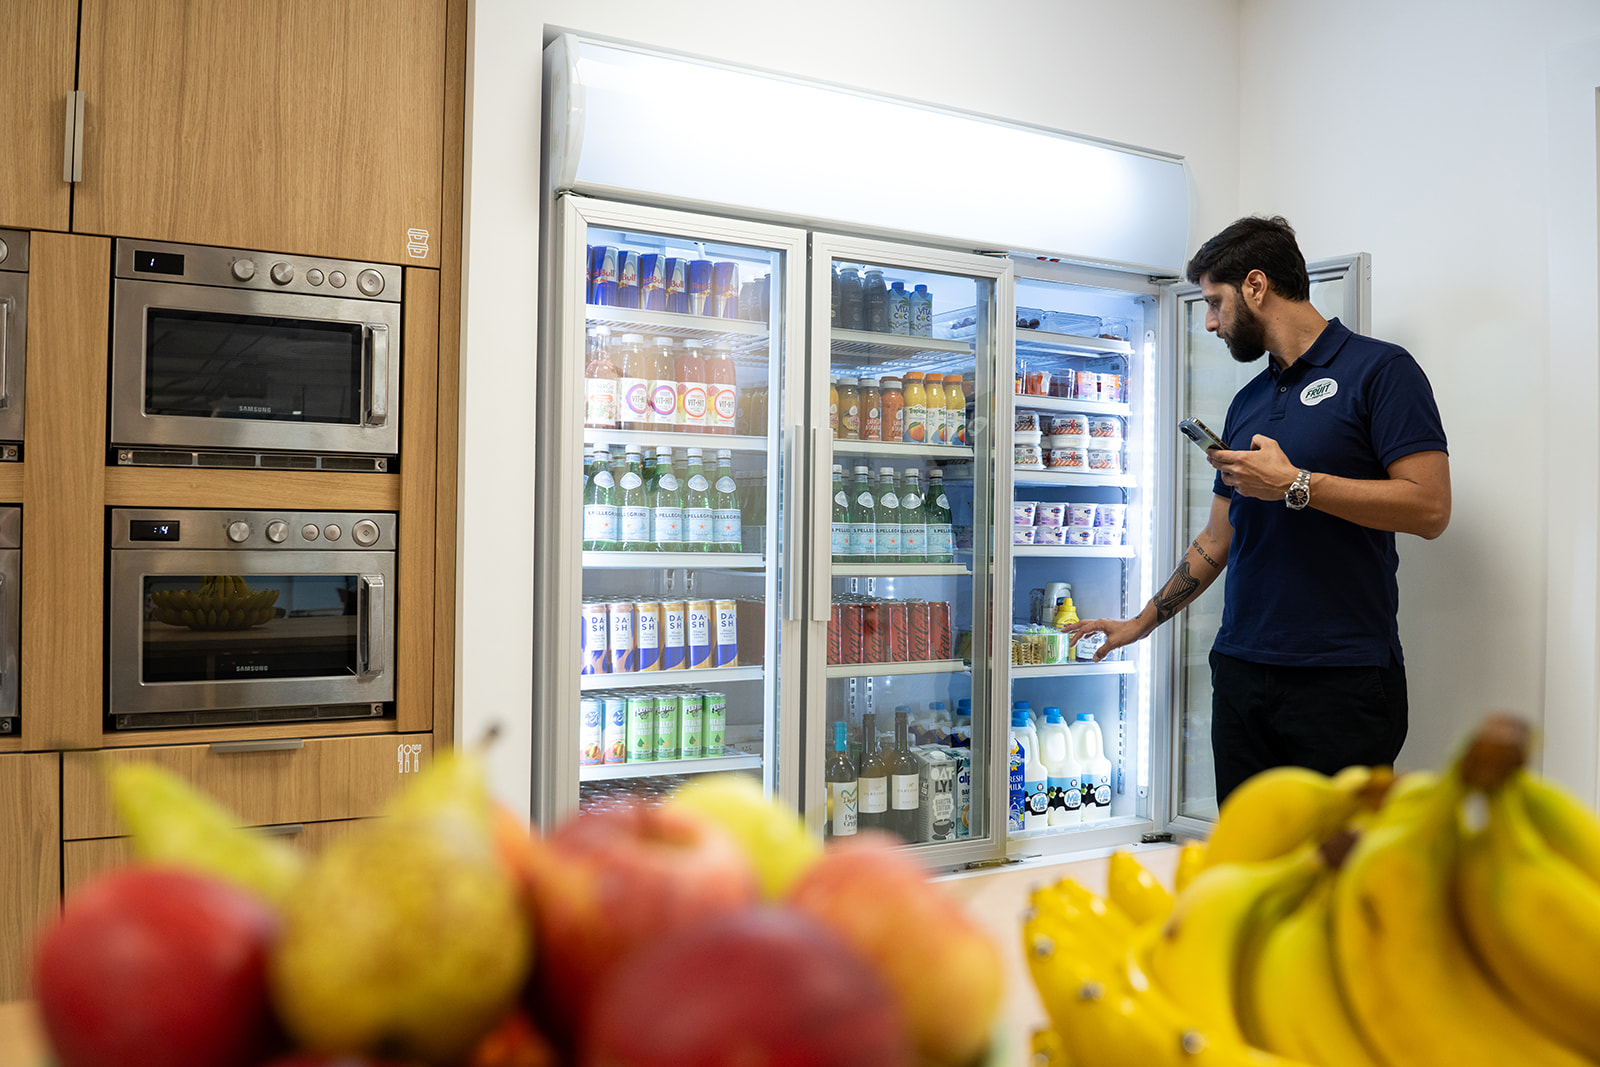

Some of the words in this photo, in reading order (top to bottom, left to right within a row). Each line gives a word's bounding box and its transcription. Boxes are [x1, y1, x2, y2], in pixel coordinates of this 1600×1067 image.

[600, 269, 615, 278] Bull
[621, 273, 636, 282] Bull
[692, 282, 707, 290] Red
[895, 304, 909, 313] VITA
[917, 307, 932, 316] VITA
[1305, 383, 1331, 398] FRUIT
[239, 405, 272, 413] SAMSUNG
[592, 624, 605, 632] SH
[615, 624, 628, 632] SH
[641, 623, 655, 631] SH
[669, 622, 682, 630] SH
[691, 621, 705, 629] SH
[721, 620, 734, 628] SH
[1009, 775, 1023, 783] RESH
[935, 779, 953, 793] LY!
